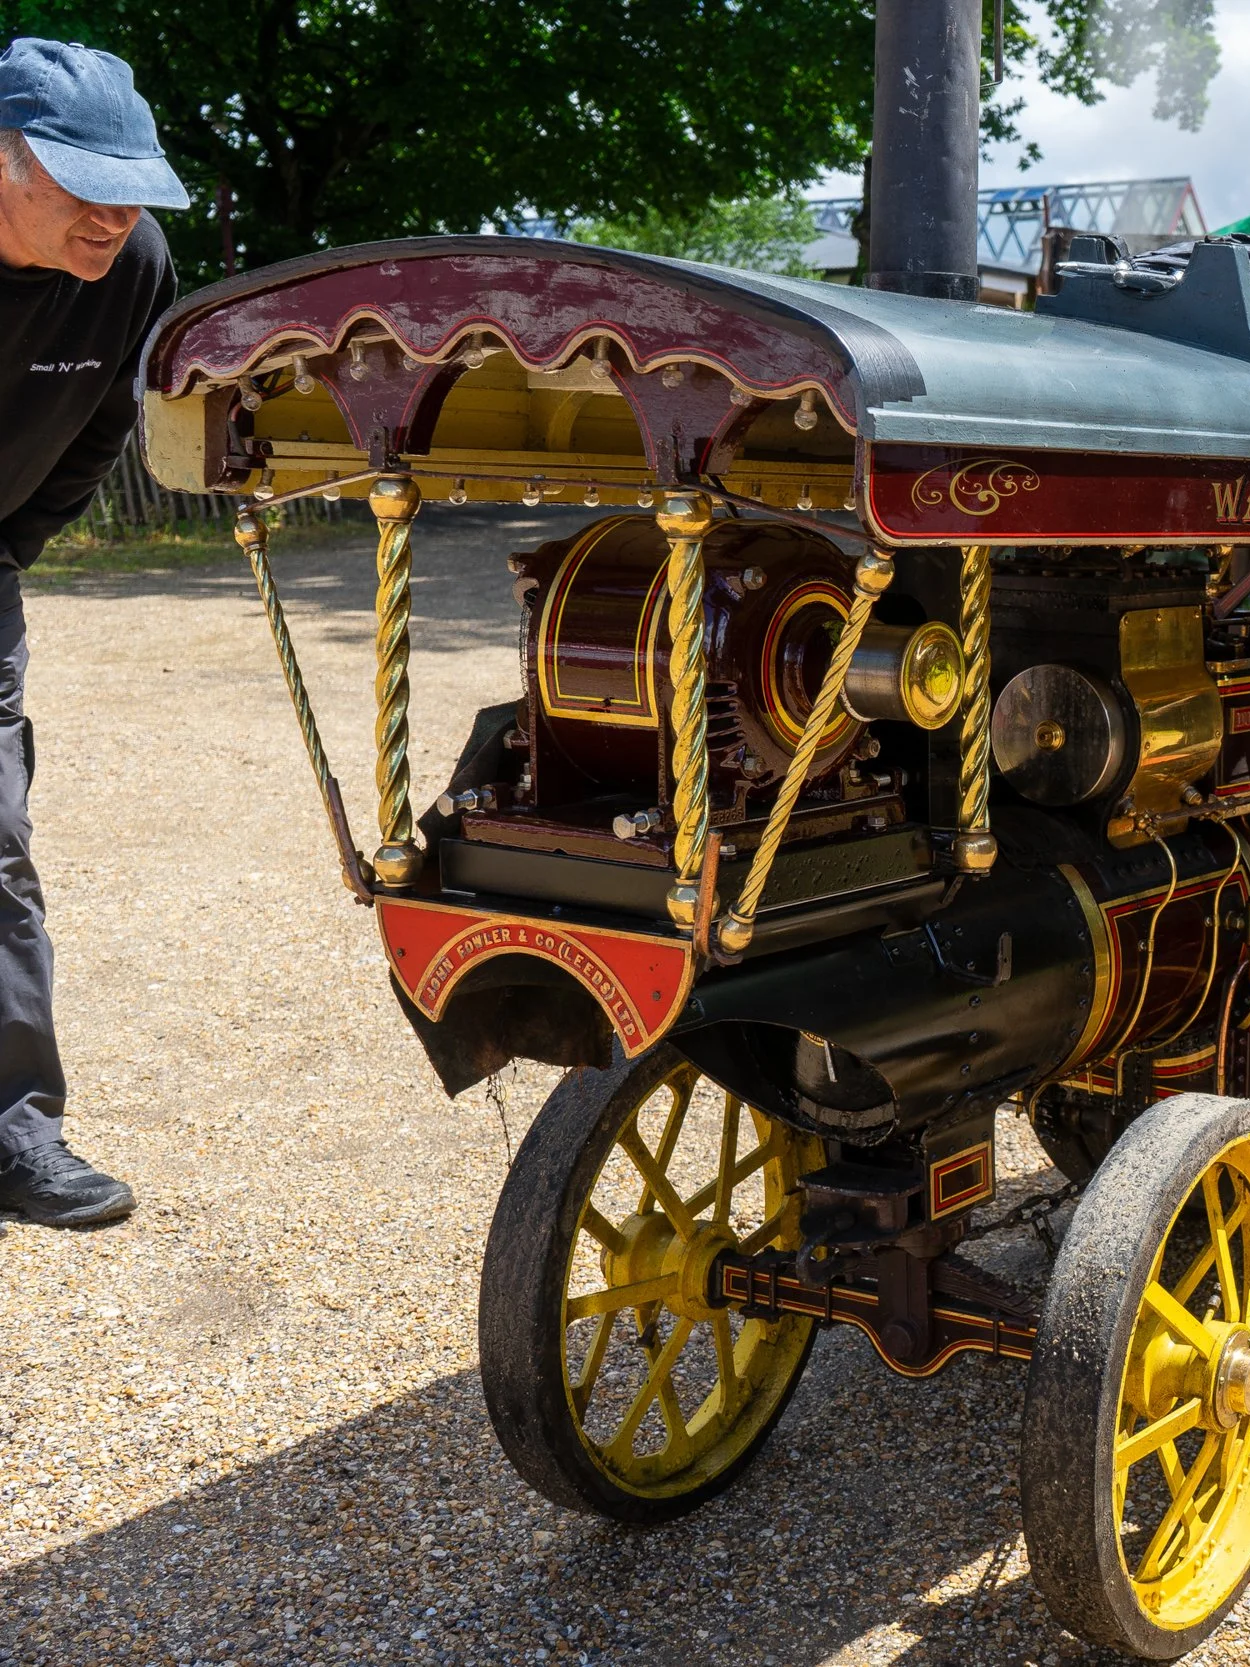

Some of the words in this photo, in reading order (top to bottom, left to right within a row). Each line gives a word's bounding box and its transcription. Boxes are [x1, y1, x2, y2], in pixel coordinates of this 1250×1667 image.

[29, 363, 55, 372] Small
[425, 955, 455, 1001] JOHN
[456, 928, 512, 961] FOWLER
[518, 929, 527, 943] &
[535, 933, 555, 951] CO
[558, 941, 617, 1002] (LEEDS)
[612, 1000, 636, 1036] LTD
